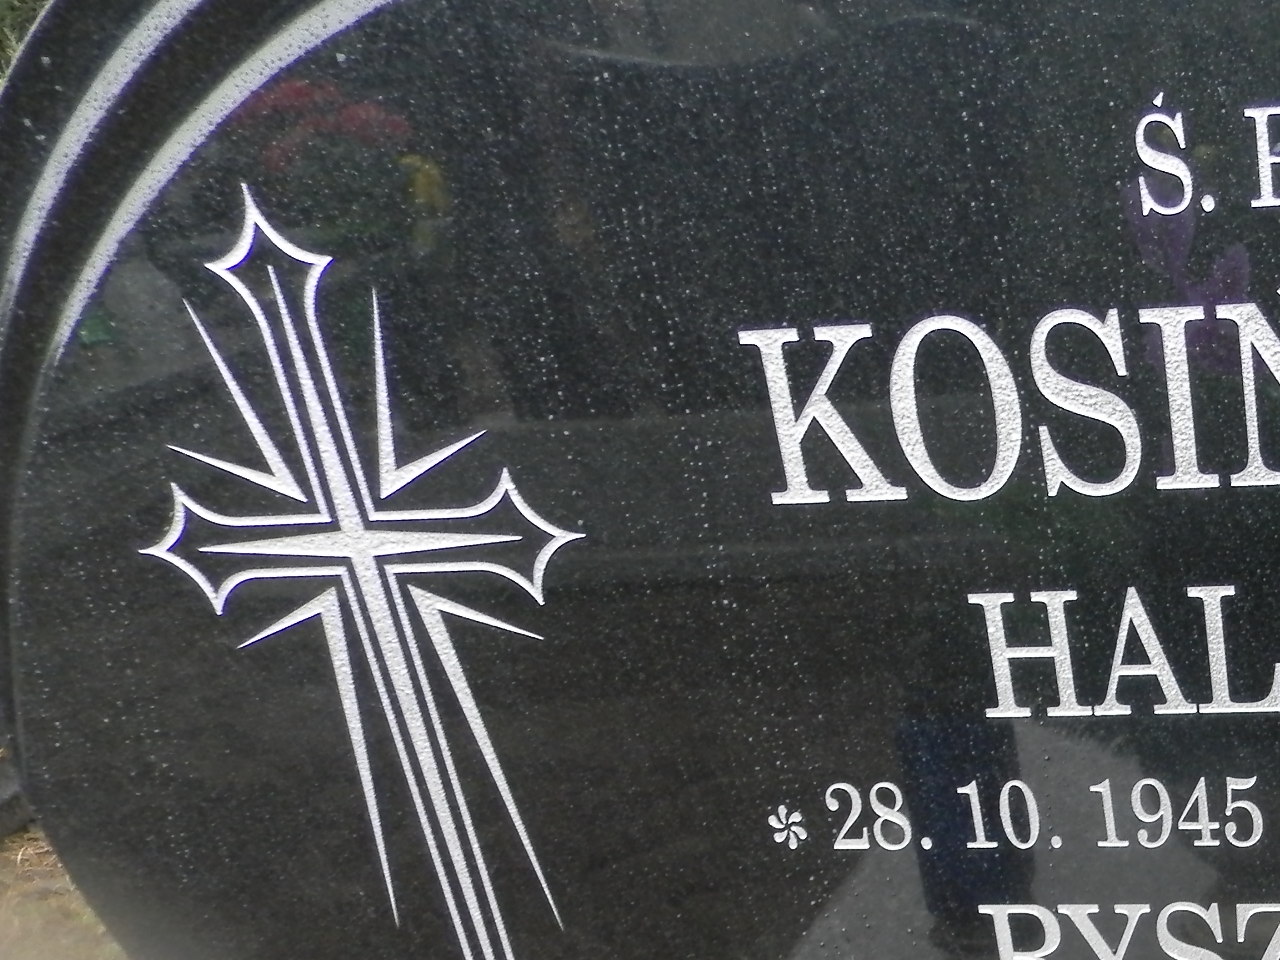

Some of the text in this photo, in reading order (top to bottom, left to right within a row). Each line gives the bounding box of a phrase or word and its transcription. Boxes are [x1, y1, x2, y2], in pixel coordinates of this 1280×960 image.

[1133, 91, 1216, 216] Ś.
[824, 782, 933, 852] 28.
[956, 780, 1063, 850] 10.
[1088, 776, 1264, 849] 1945
